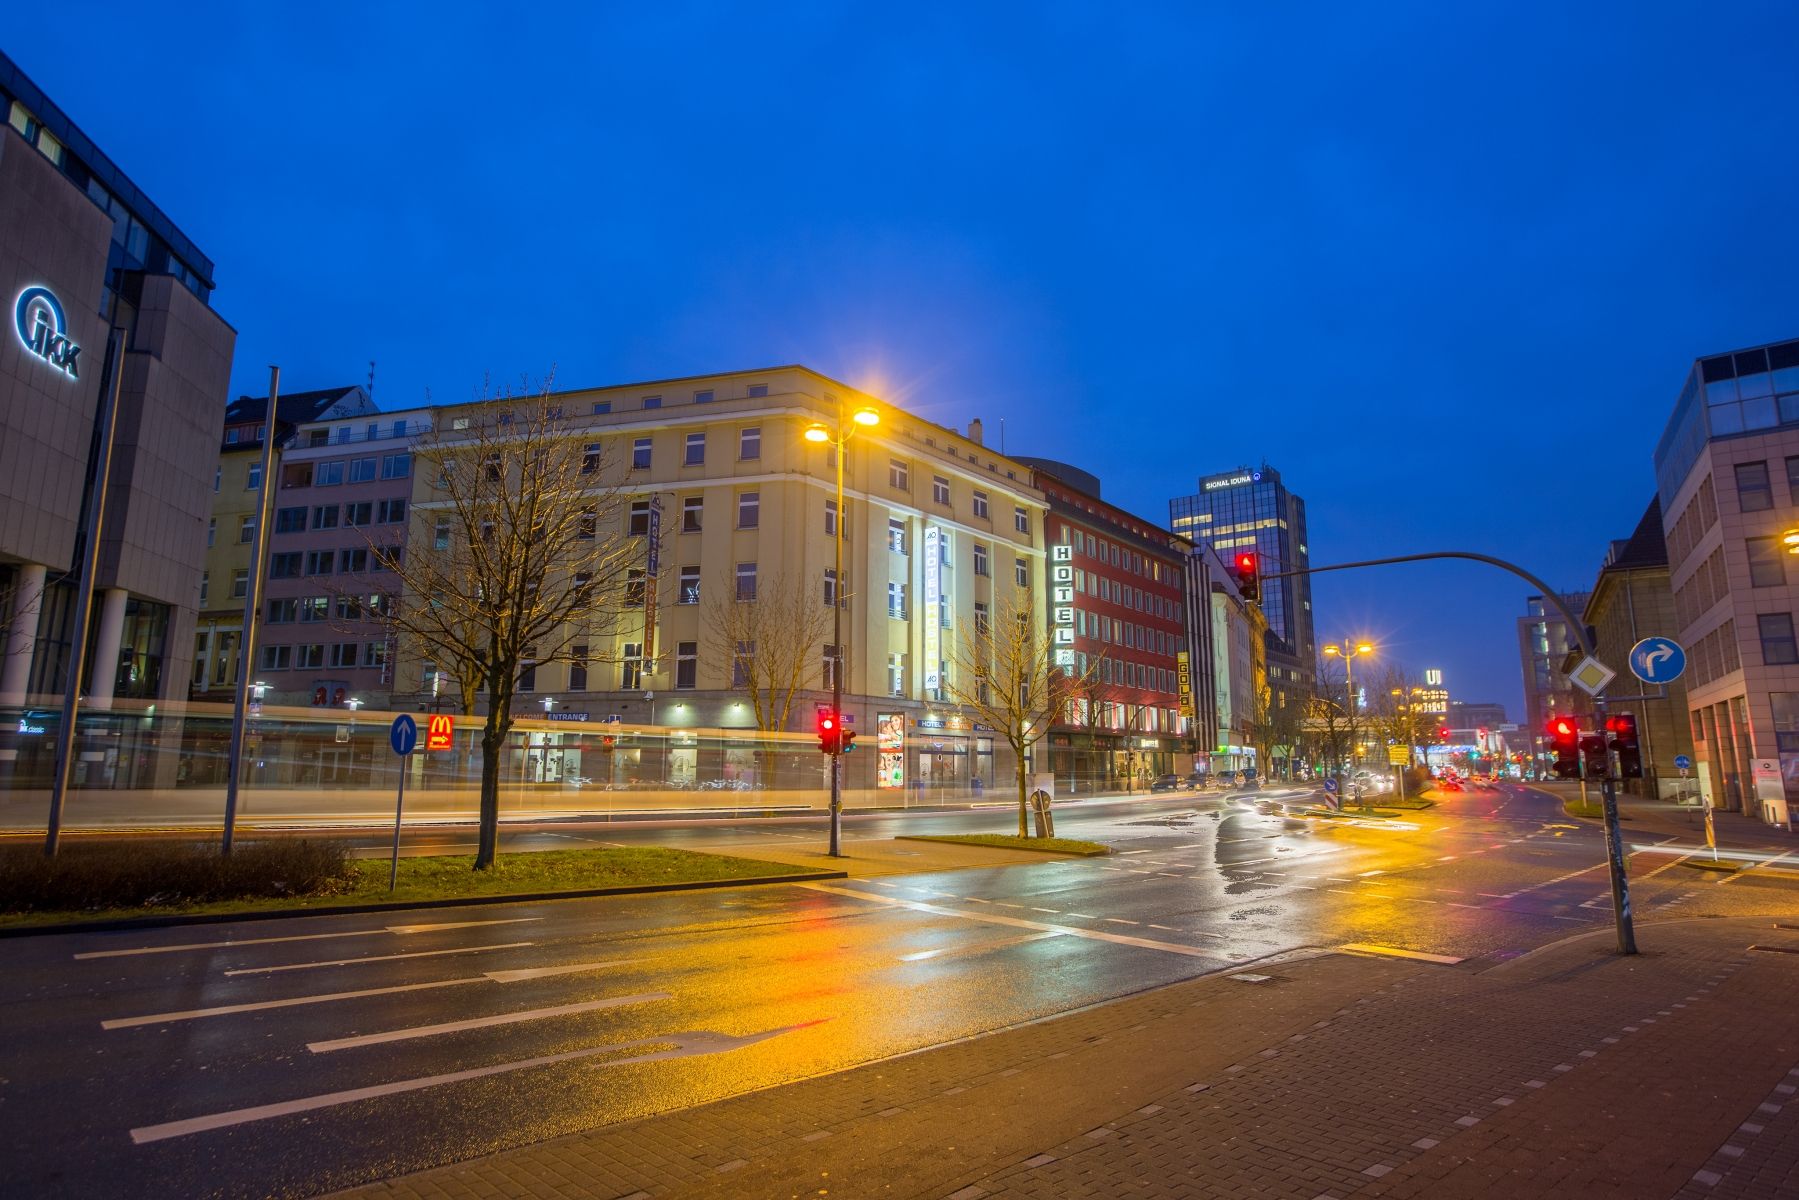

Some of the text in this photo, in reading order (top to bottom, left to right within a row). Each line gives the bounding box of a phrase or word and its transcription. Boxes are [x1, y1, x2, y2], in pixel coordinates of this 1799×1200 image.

[1206, 475, 1251, 489] SIGNAL IDUNA
[928, 544, 937, 599] HOTEL
[1057, 547, 1071, 642] HOTEL
[1180, 663, 1190, 706] GOLD
[547, 713, 588, 721] ENTRANCE
[921, 720, 942, 728] HOTEL
